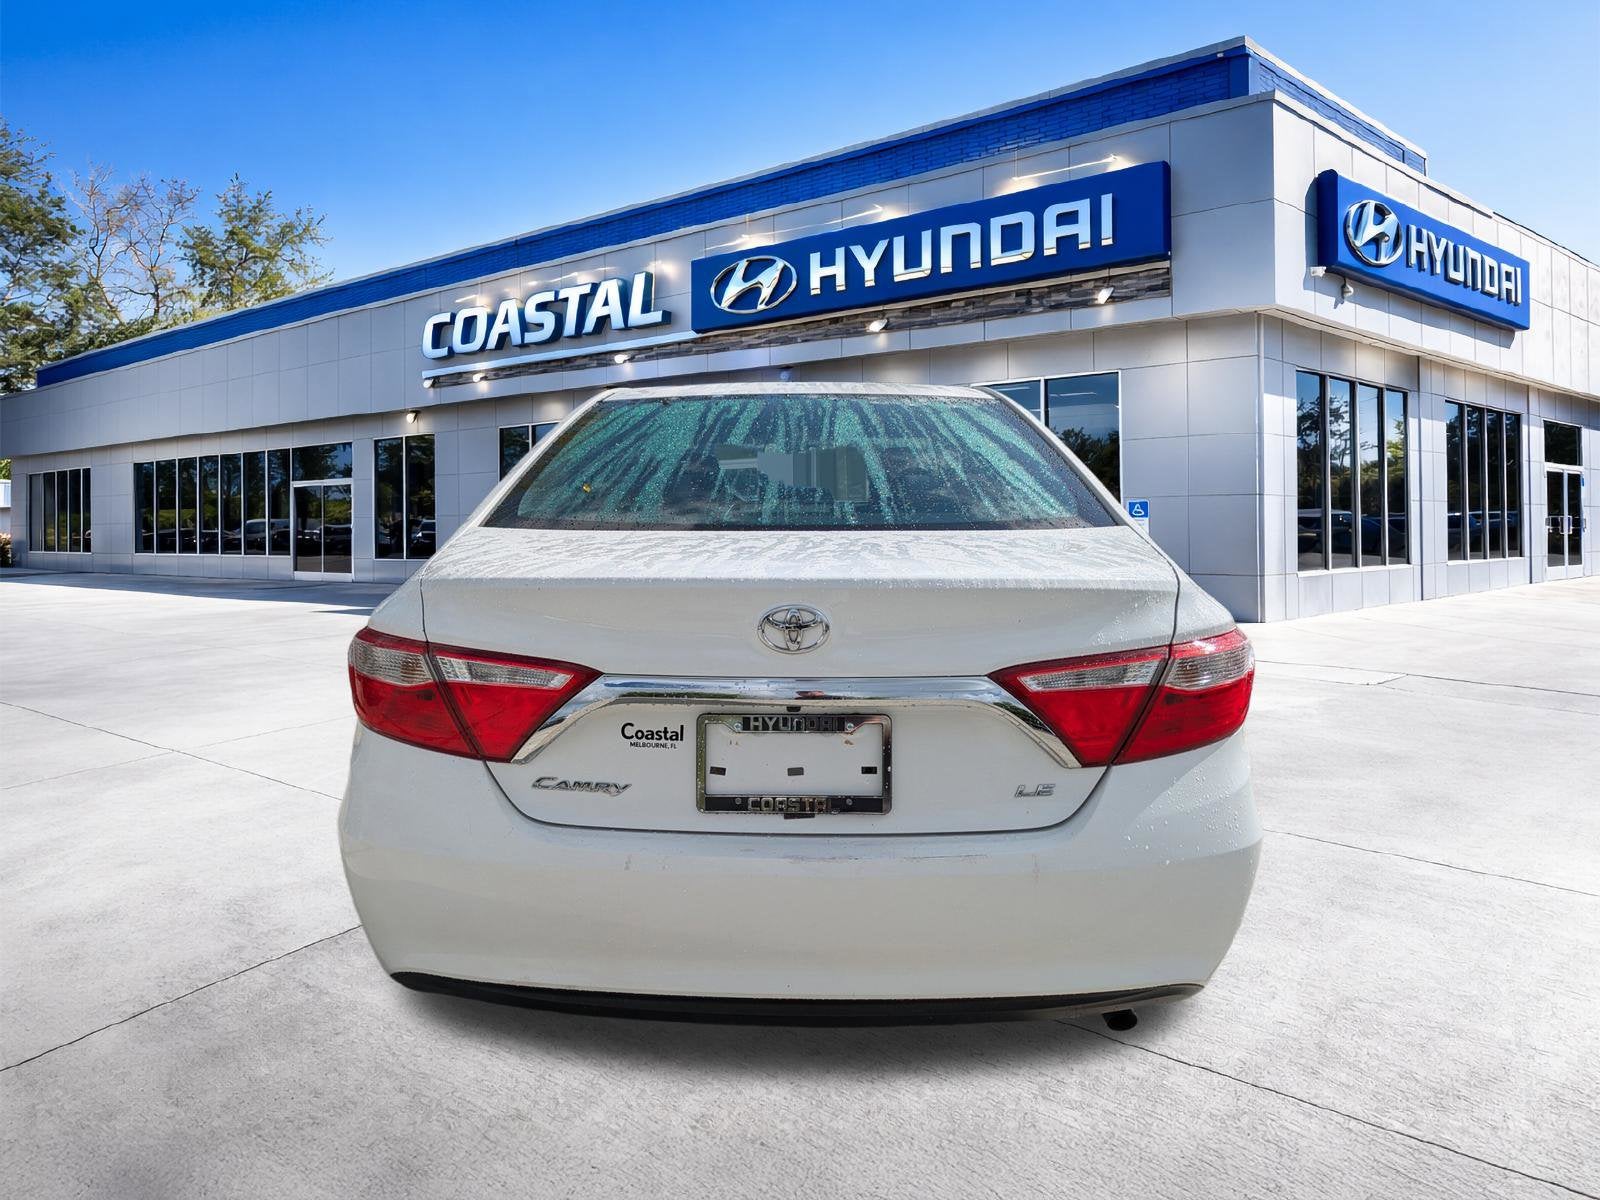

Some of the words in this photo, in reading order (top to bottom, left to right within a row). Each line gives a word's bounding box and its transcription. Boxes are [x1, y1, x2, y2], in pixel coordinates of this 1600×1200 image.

[810, 193, 1113, 295] HYUNDAI
[1406, 224, 1521, 306] HYUNDAI
[422, 271, 668, 359] COASTAL
[621, 722, 684, 742] Coastal
[629, 741, 670, 750] MELBOURNE,
[531, 776, 632, 797] CAMRY
[1014, 783, 1056, 797] LE
